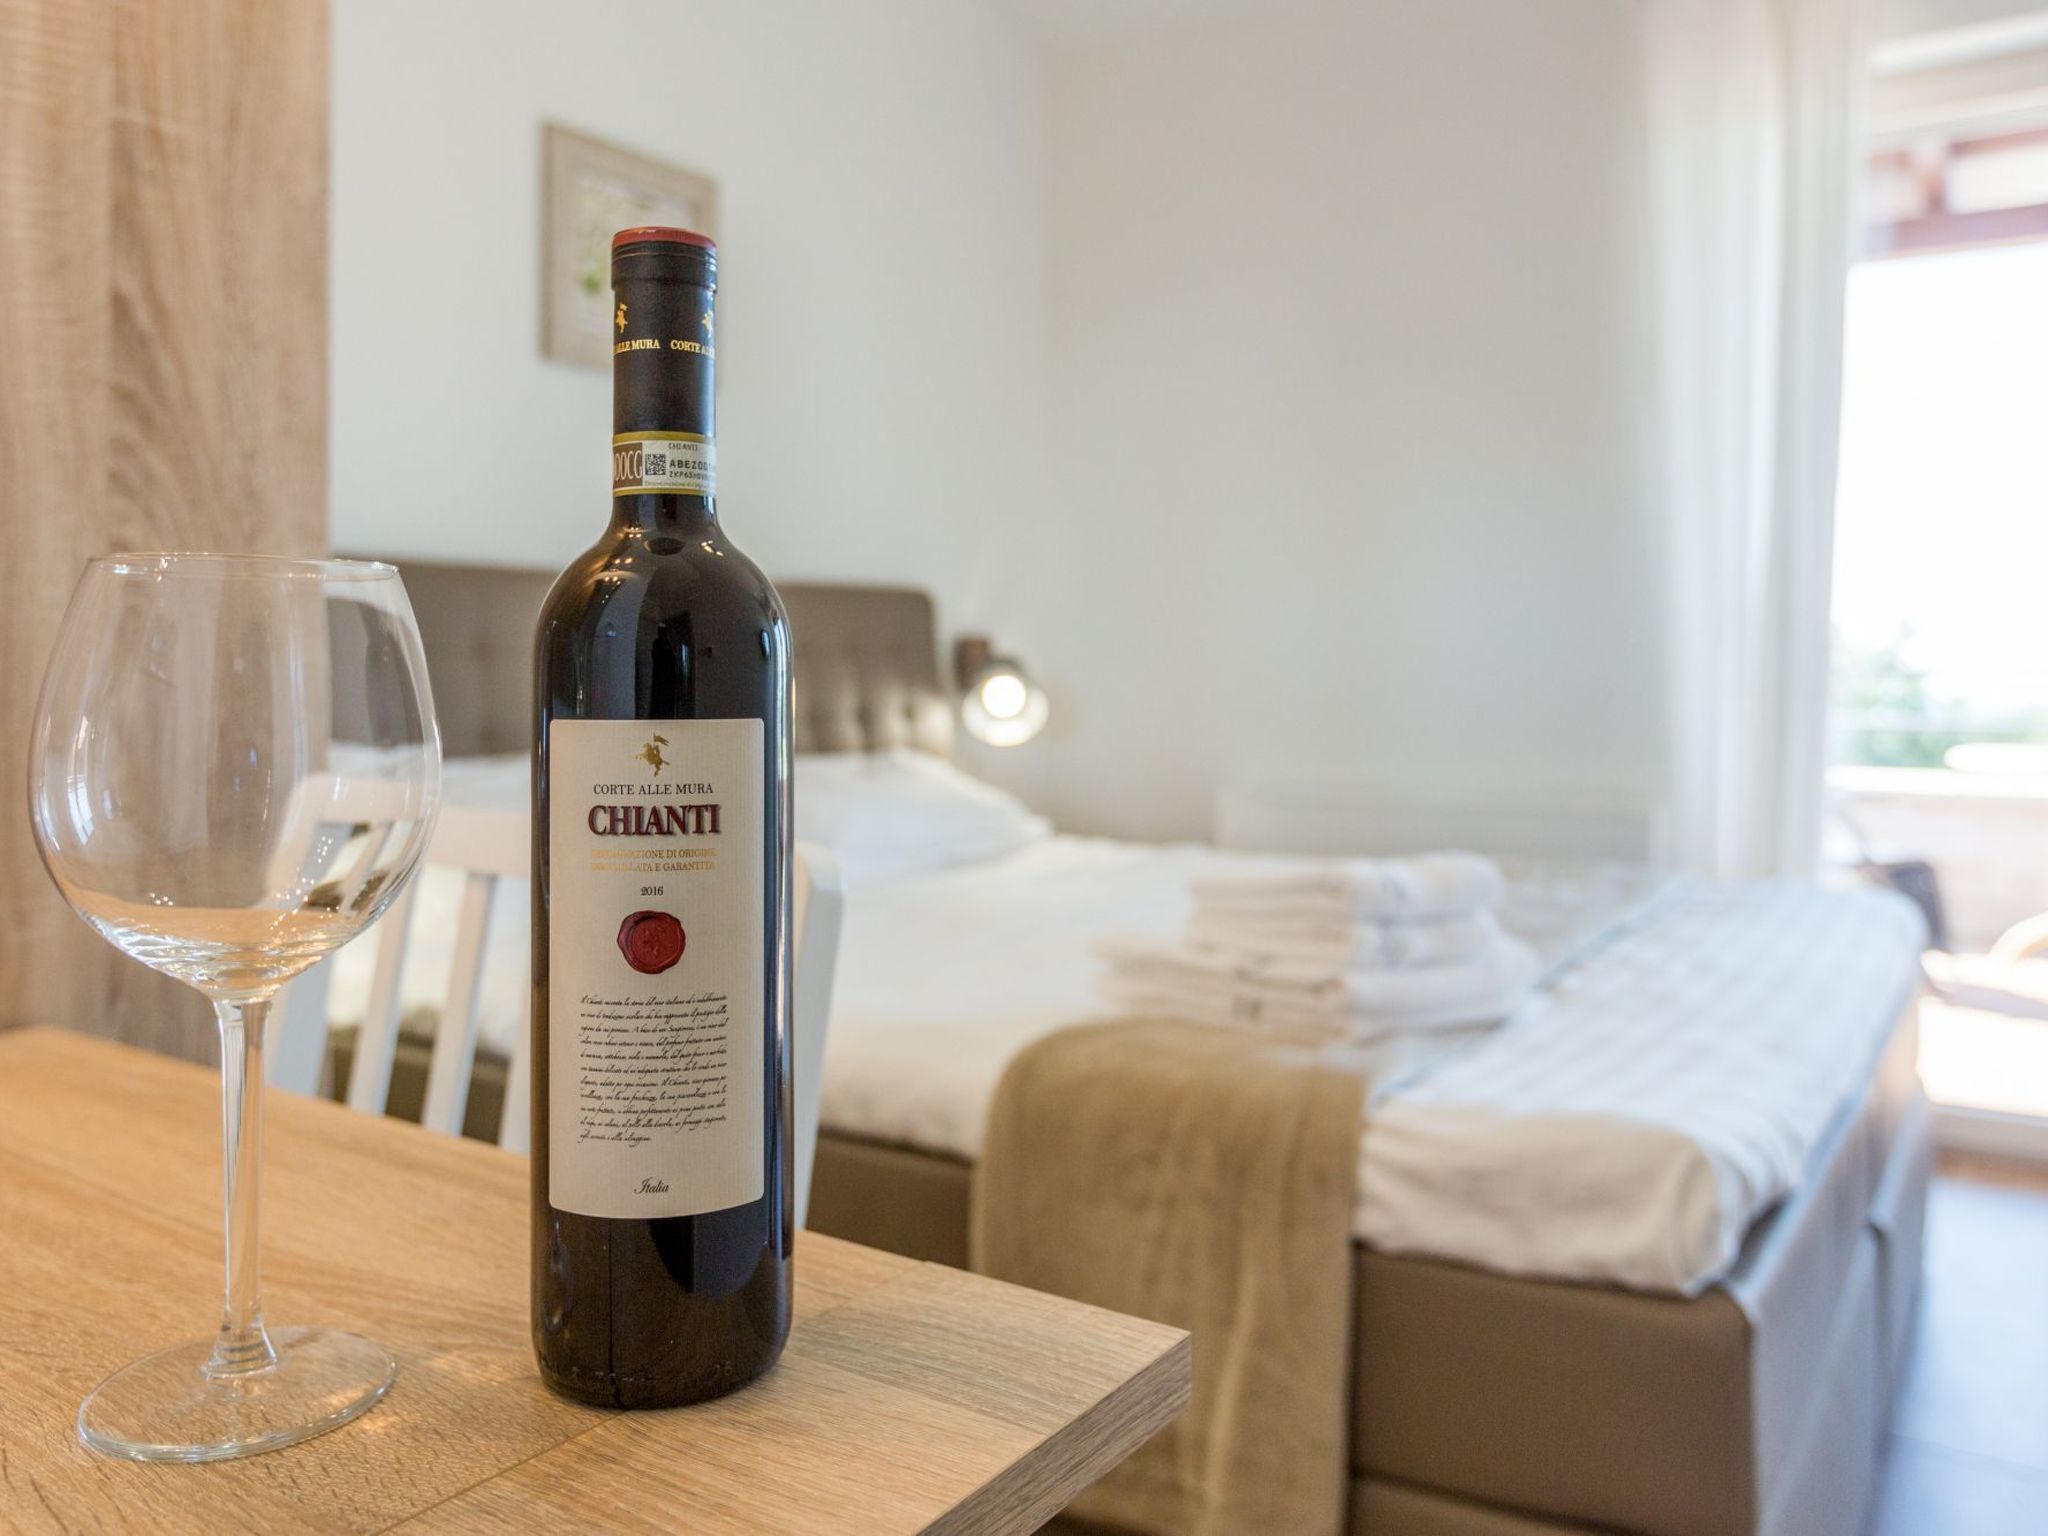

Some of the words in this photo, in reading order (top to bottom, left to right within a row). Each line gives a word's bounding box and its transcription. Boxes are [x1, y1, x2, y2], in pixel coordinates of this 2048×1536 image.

[631, 339, 661, 350] MURA
[670, 339, 701, 353] CORTE
[593, 783, 635, 795] CORTE
[638, 783, 672, 795] ALLE
[675, 783, 714, 795] MURA
[587, 804, 721, 836] CHIANTI
[666, 849, 677, 859] DI
[654, 862, 662, 872] E
[641, 886, 664, 896] 2016
[633, 1176, 669, 1195] Italia
